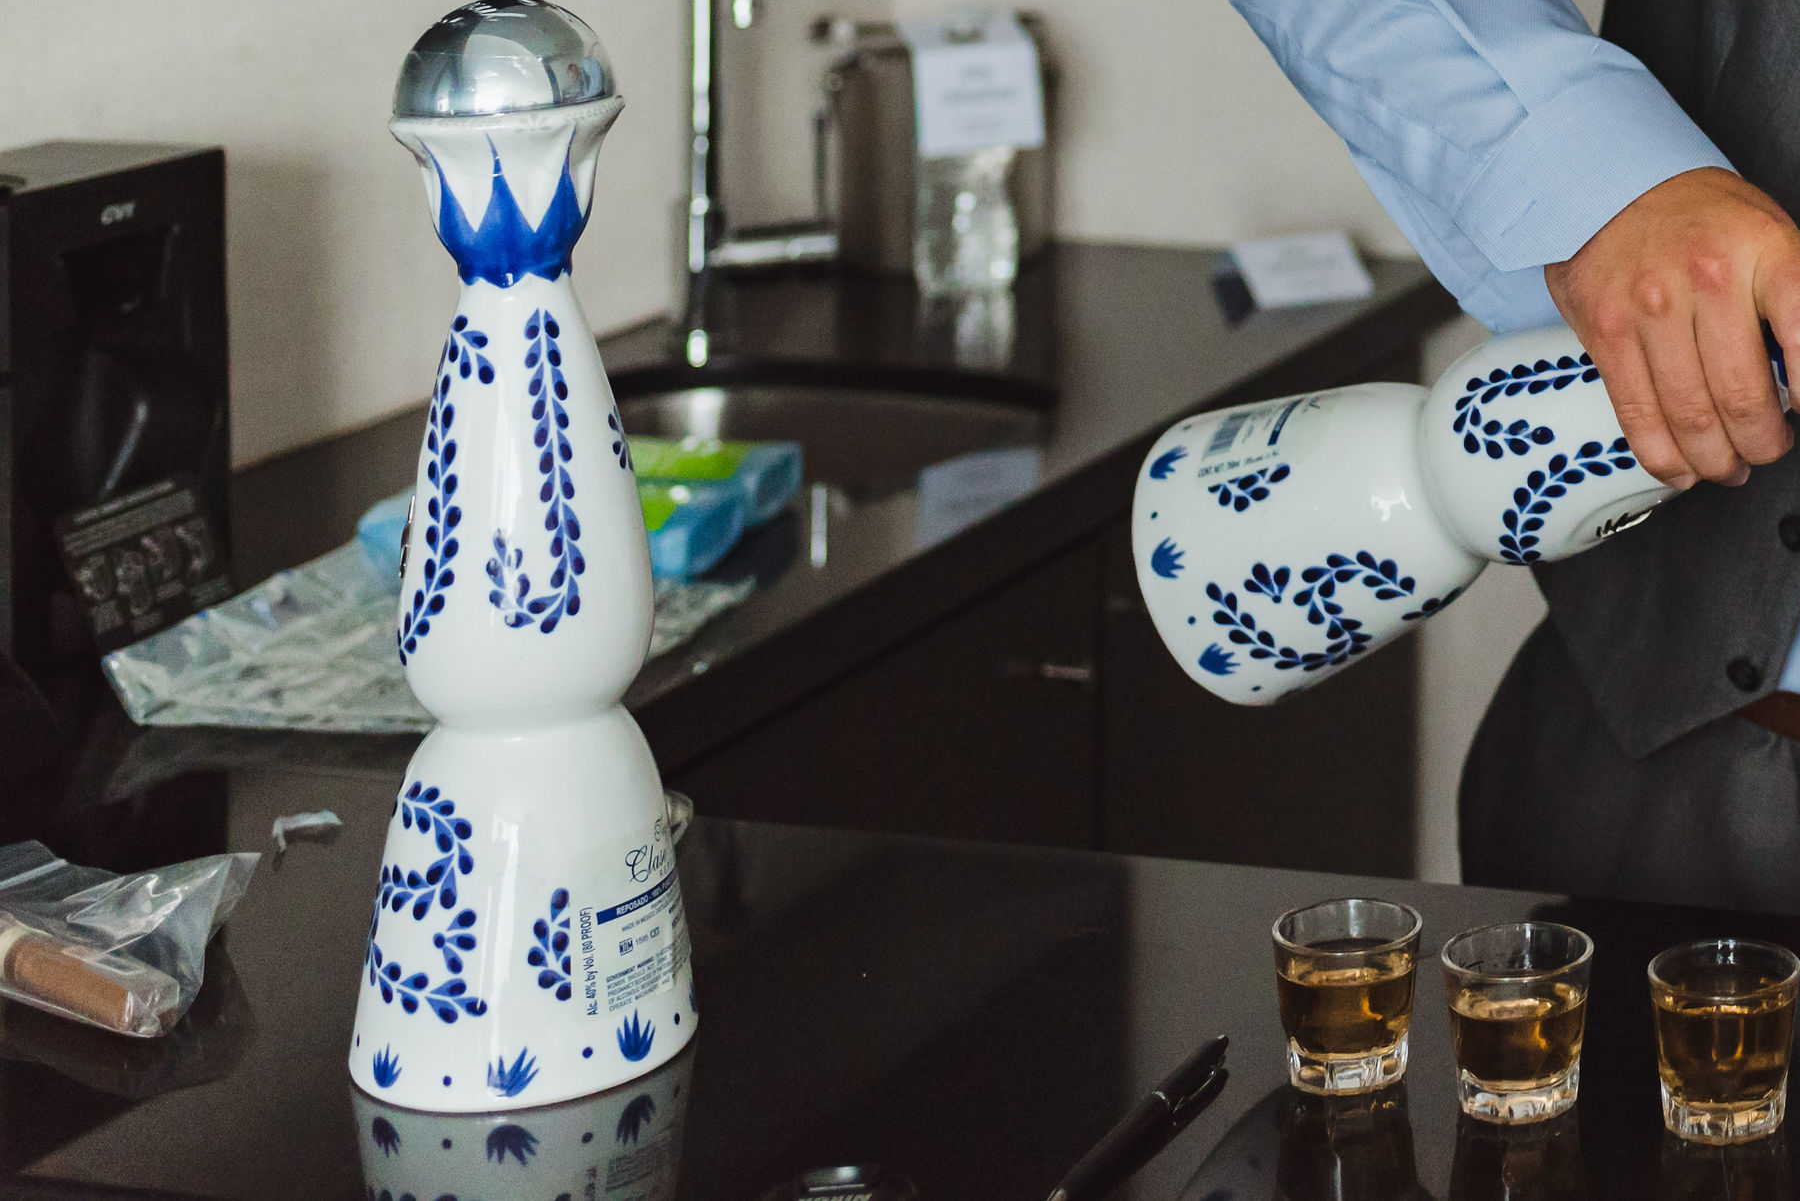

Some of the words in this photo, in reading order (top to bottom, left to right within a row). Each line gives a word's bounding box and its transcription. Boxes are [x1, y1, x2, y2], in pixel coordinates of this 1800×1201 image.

[625, 844, 668, 883] Clas
[616, 894, 649, 916] REPOSADO
[580, 906, 593, 940] PROOF)
[582, 940, 595, 954] (80
[585, 970, 598, 982] by
[606, 965, 636, 984] GOVERNMENT
[584, 981, 596, 999] 40%
[586, 999, 598, 1015] Alc.
[609, 998, 632, 1012] OPERATE
